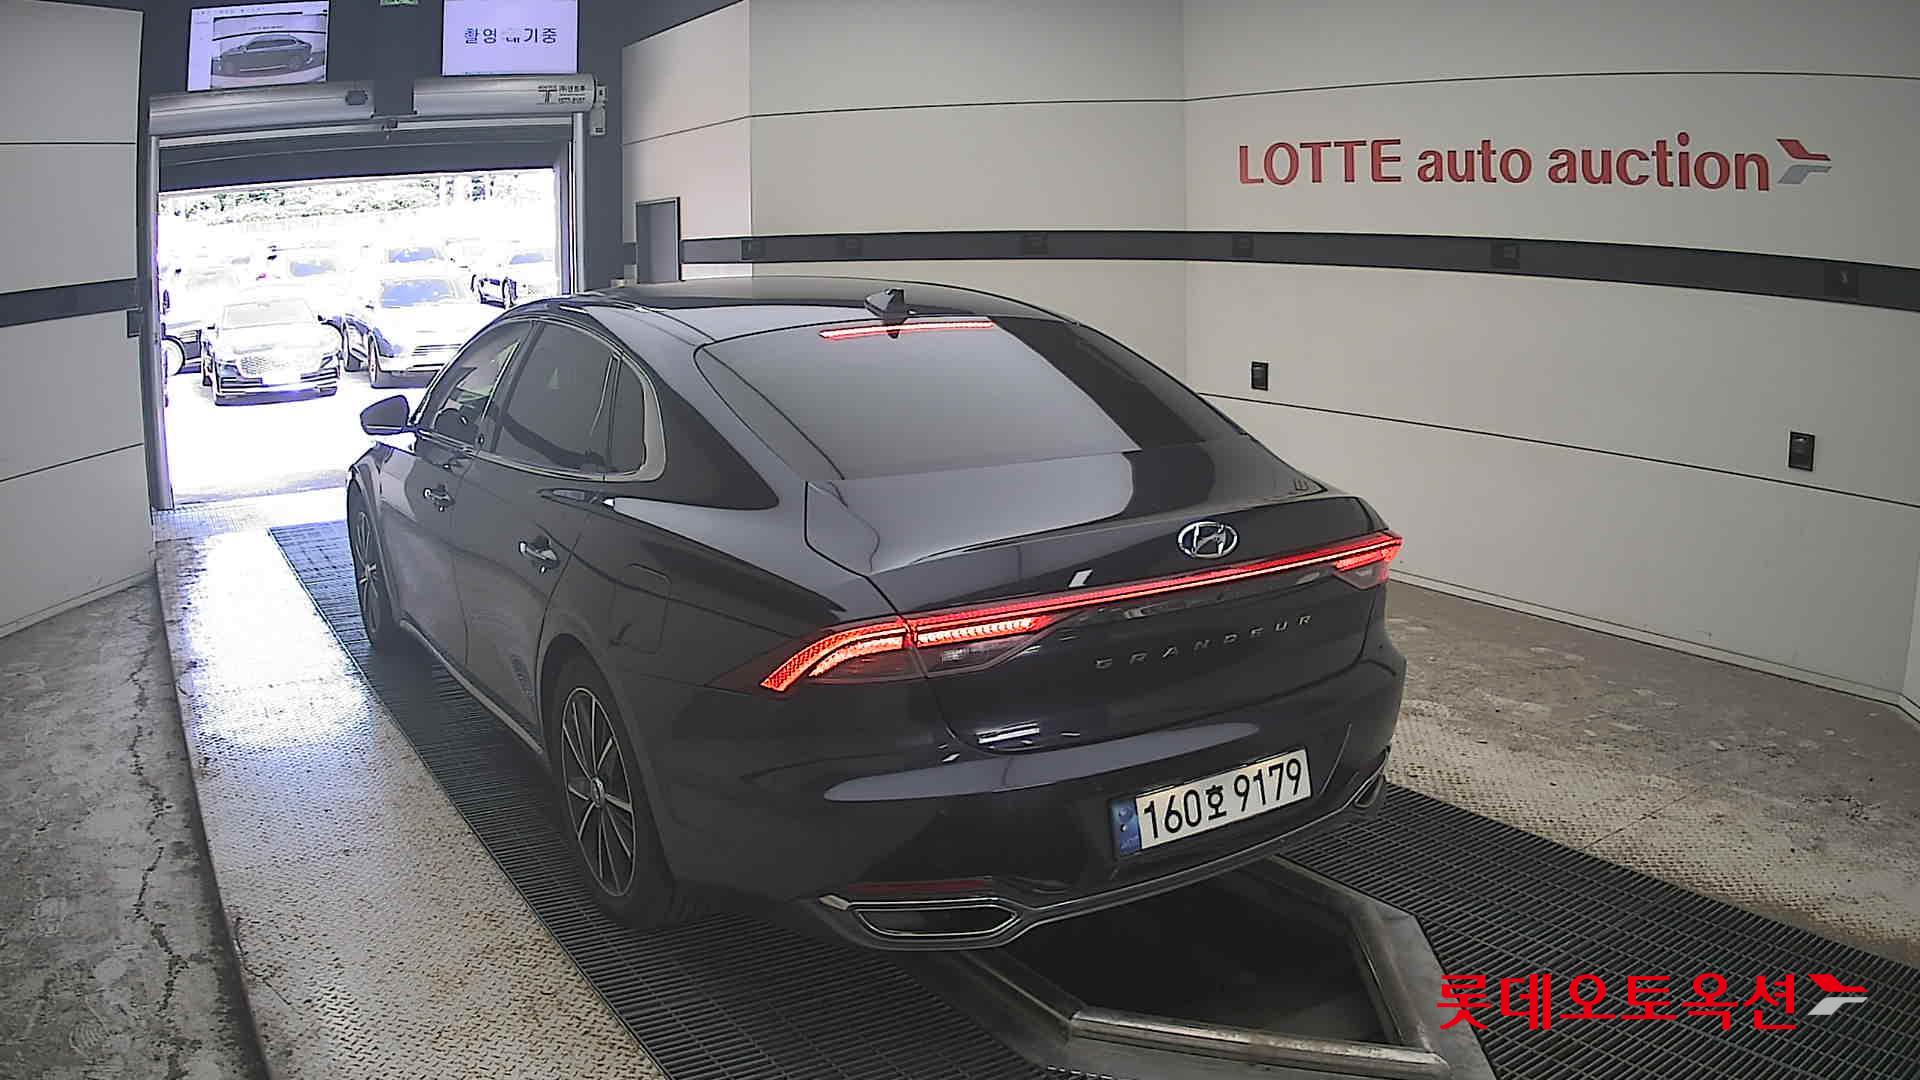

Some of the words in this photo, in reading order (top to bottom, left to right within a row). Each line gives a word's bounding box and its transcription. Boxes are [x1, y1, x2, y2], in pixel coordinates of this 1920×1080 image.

[1239, 138, 1402, 185] LOTTE
[1416, 139, 1533, 184] auto
[1547, 132, 1771, 191] auction
[1095, 615, 1312, 670] GRANDEUR
[1143, 784, 1227, 839] 160호
[1233, 758, 1302, 812] 9179
